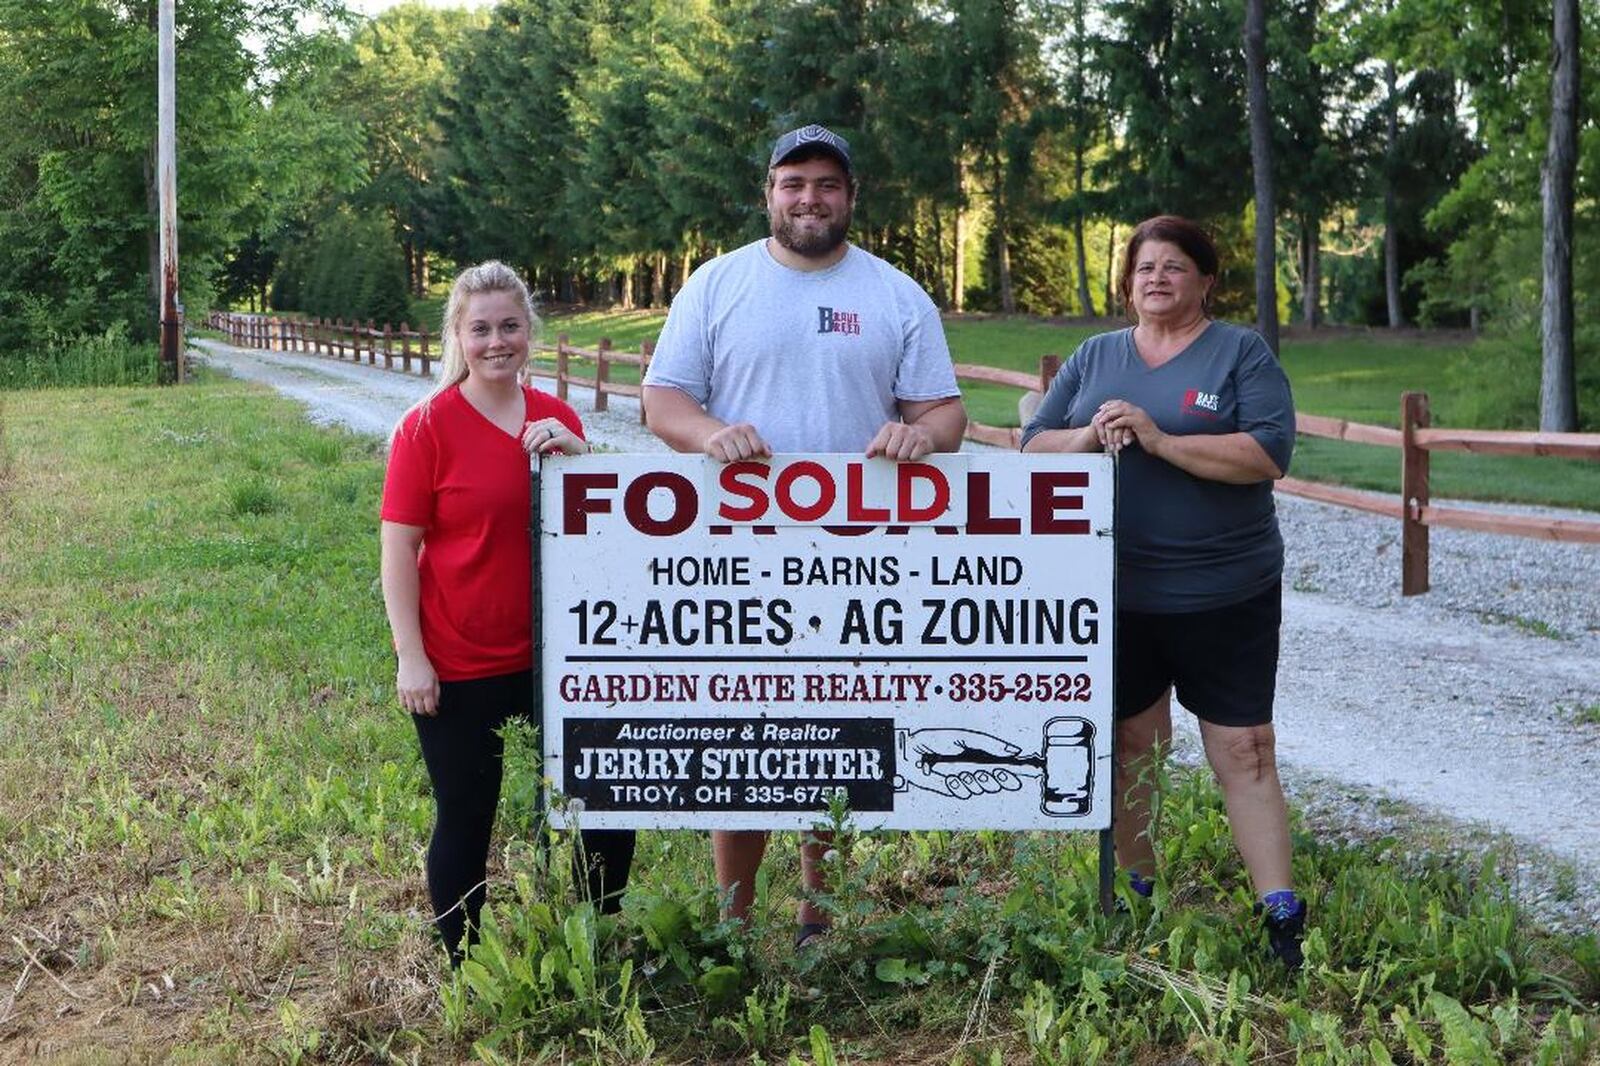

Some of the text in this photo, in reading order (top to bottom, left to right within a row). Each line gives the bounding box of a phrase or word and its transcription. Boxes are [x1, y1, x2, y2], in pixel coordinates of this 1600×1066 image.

[563, 471, 1091, 536] FO LE
[719, 460, 950, 522] SOLD
[652, 556, 750, 586] HOME
[783, 556, 900, 586] BARNS
[931, 556, 1023, 586] LAND
[839, 597, 904, 646] AG
[921, 597, 1099, 646] ZONING
[559, 673, 1092, 703] GARDEN GATE REALTY 335-2522
[616, 723, 841, 741] Auctioneer & Realtor
[574, 747, 884, 780] JERRY STICHTER
[610, 785, 685, 806] TROY,
[695, 786, 732, 804] OH
